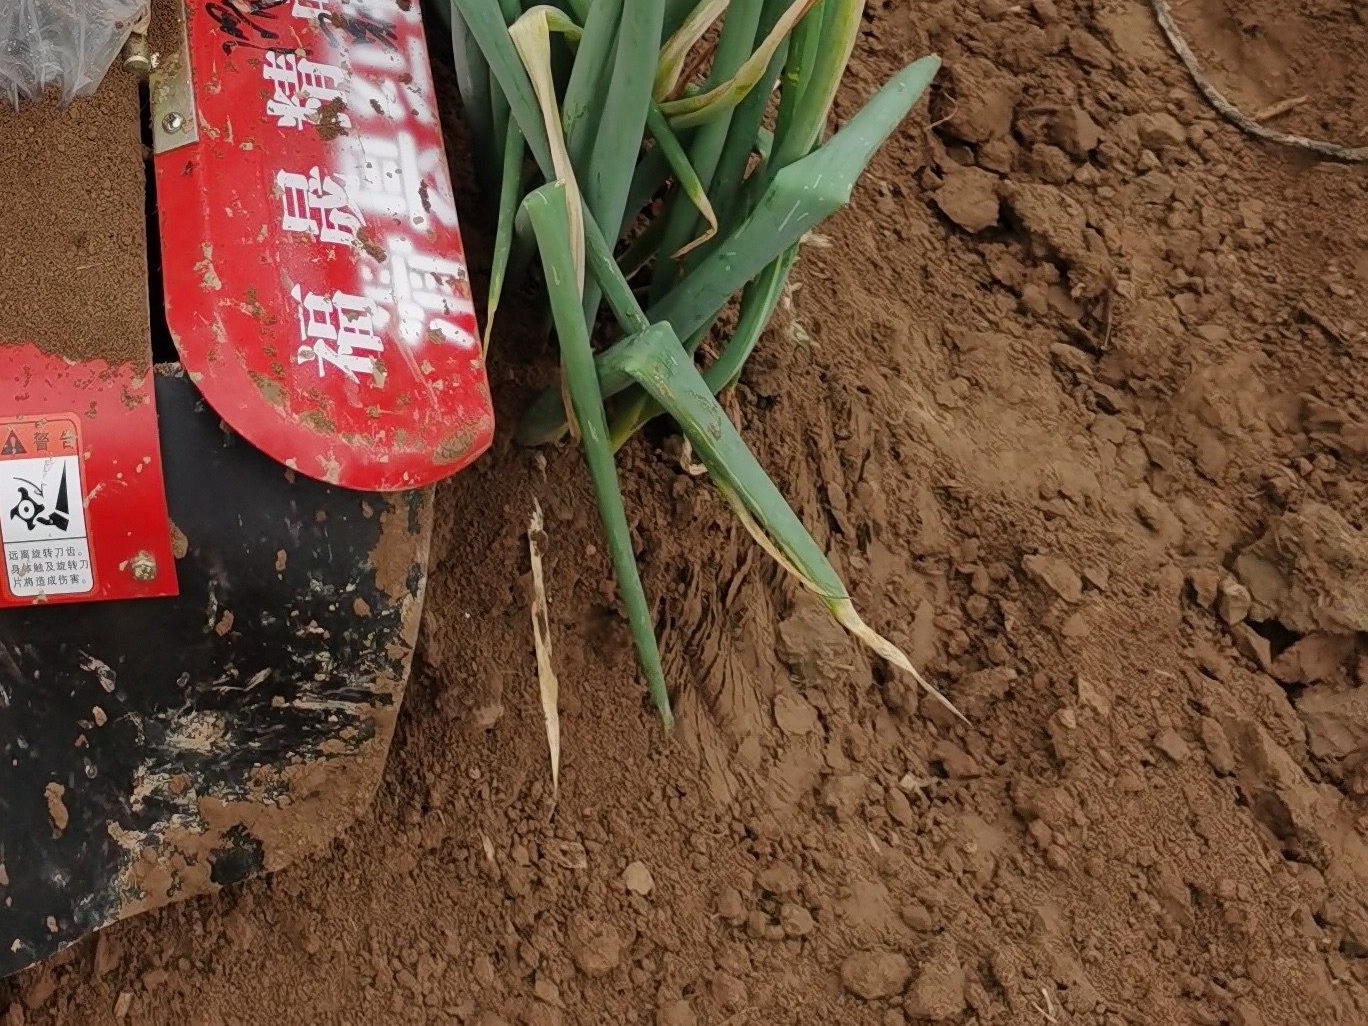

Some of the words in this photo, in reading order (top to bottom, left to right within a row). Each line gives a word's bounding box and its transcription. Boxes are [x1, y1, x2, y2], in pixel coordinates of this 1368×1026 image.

[33, 429, 77, 452] 警告
[8, 546, 83, 562] 远离旋转刀齿。
[11, 559, 89, 575] 身体触及旋转刀
[13, 573, 87, 589] 片将造成伤害。
